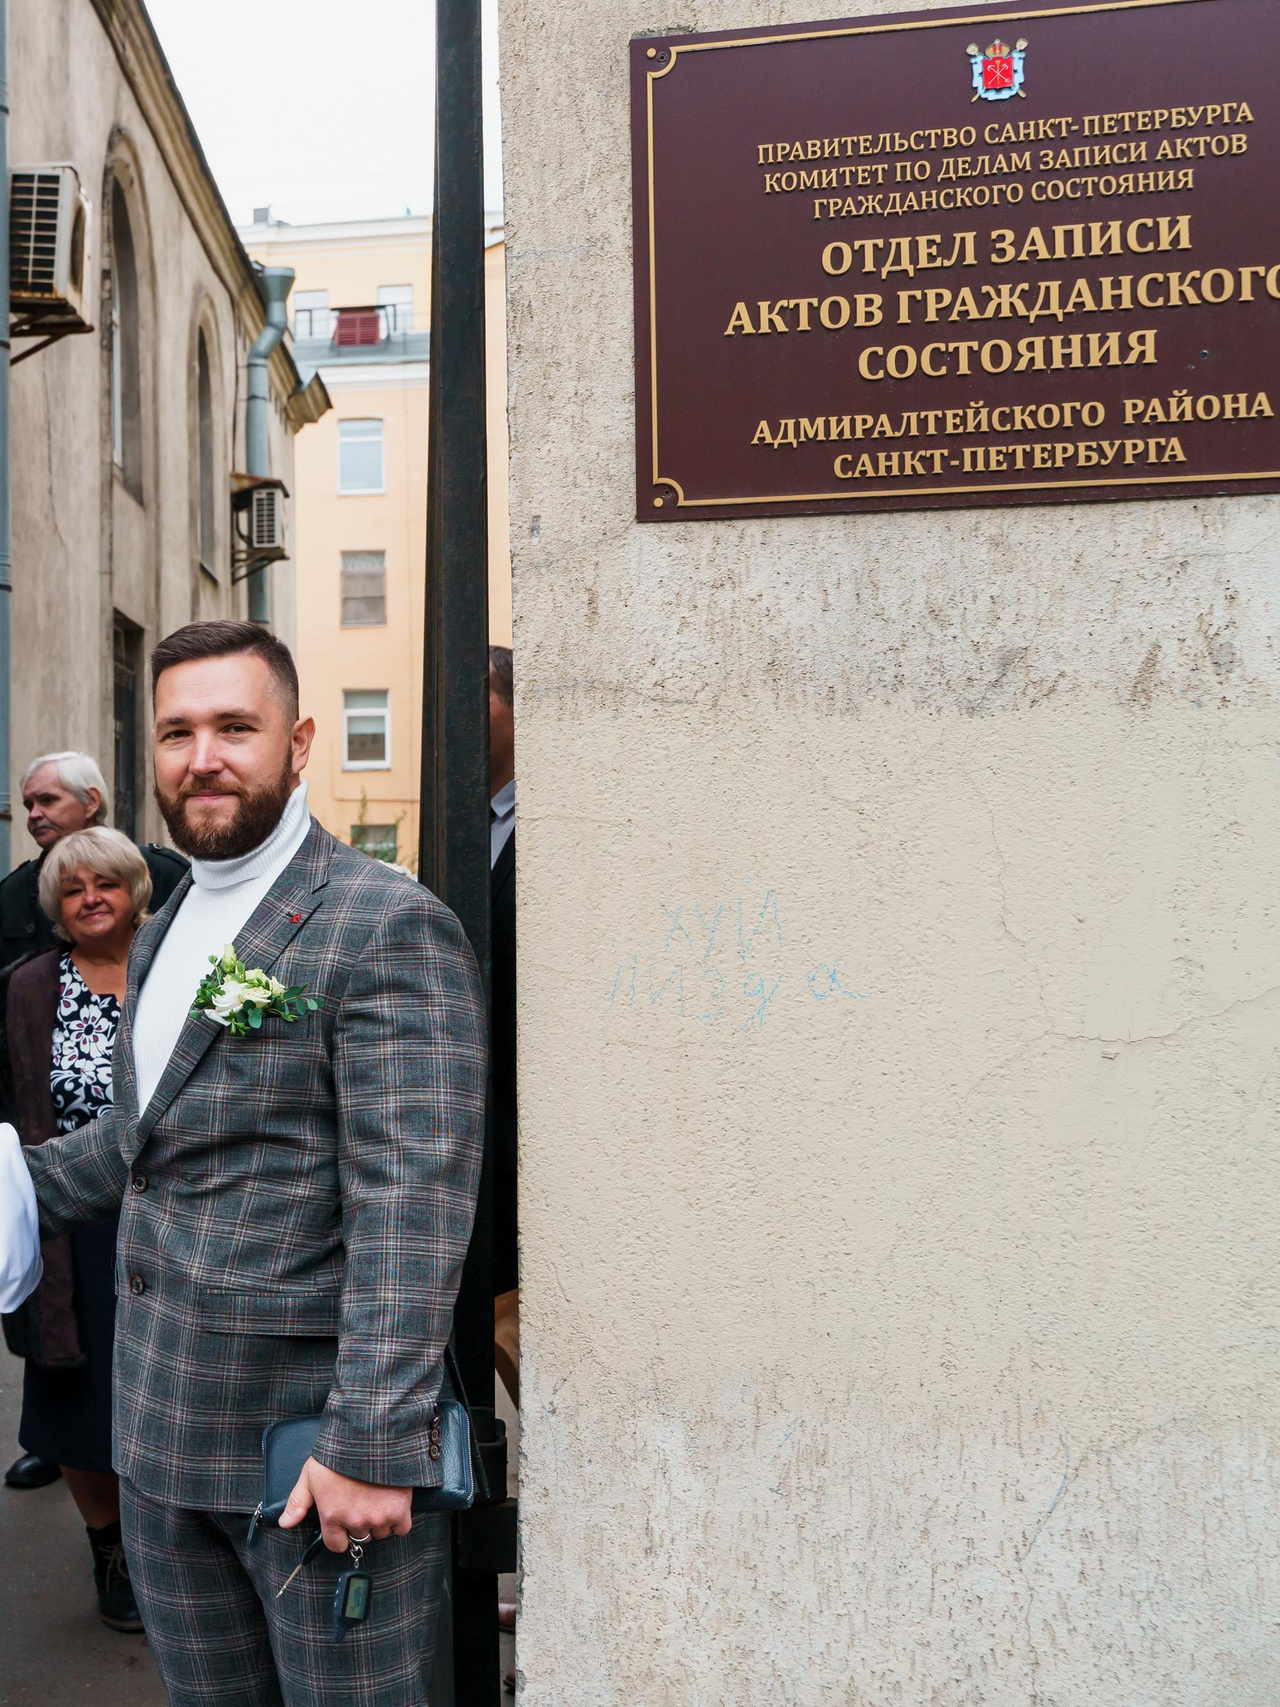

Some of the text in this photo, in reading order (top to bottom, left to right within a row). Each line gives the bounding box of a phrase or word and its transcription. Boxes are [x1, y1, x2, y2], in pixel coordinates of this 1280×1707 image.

[758, 102, 1254, 163] ПРАВИТЕЛЬСТВО САНКТ-ПЕТЕРБУРГА
[764, 134, 1247, 192] КОМИТЕТ ПО ДЕЛАМ ЗАПИСИ АКТОВ
[814, 169, 1194, 218] ГРАЖДАНСКОГО СОСТОЯНИЯ
[822, 215, 1192, 279] ОТДЕЛ ЗАПИСИ
[724, 294, 883, 335] АКТОВ
[859, 330, 1157, 379] СОСТОЯНИЯ
[751, 389, 1274, 448] АДМИРАЛТЕЙСКОГО РАЙОНА
[834, 437, 1186, 478] САНКТ-ПЕТЕРБУРГА
